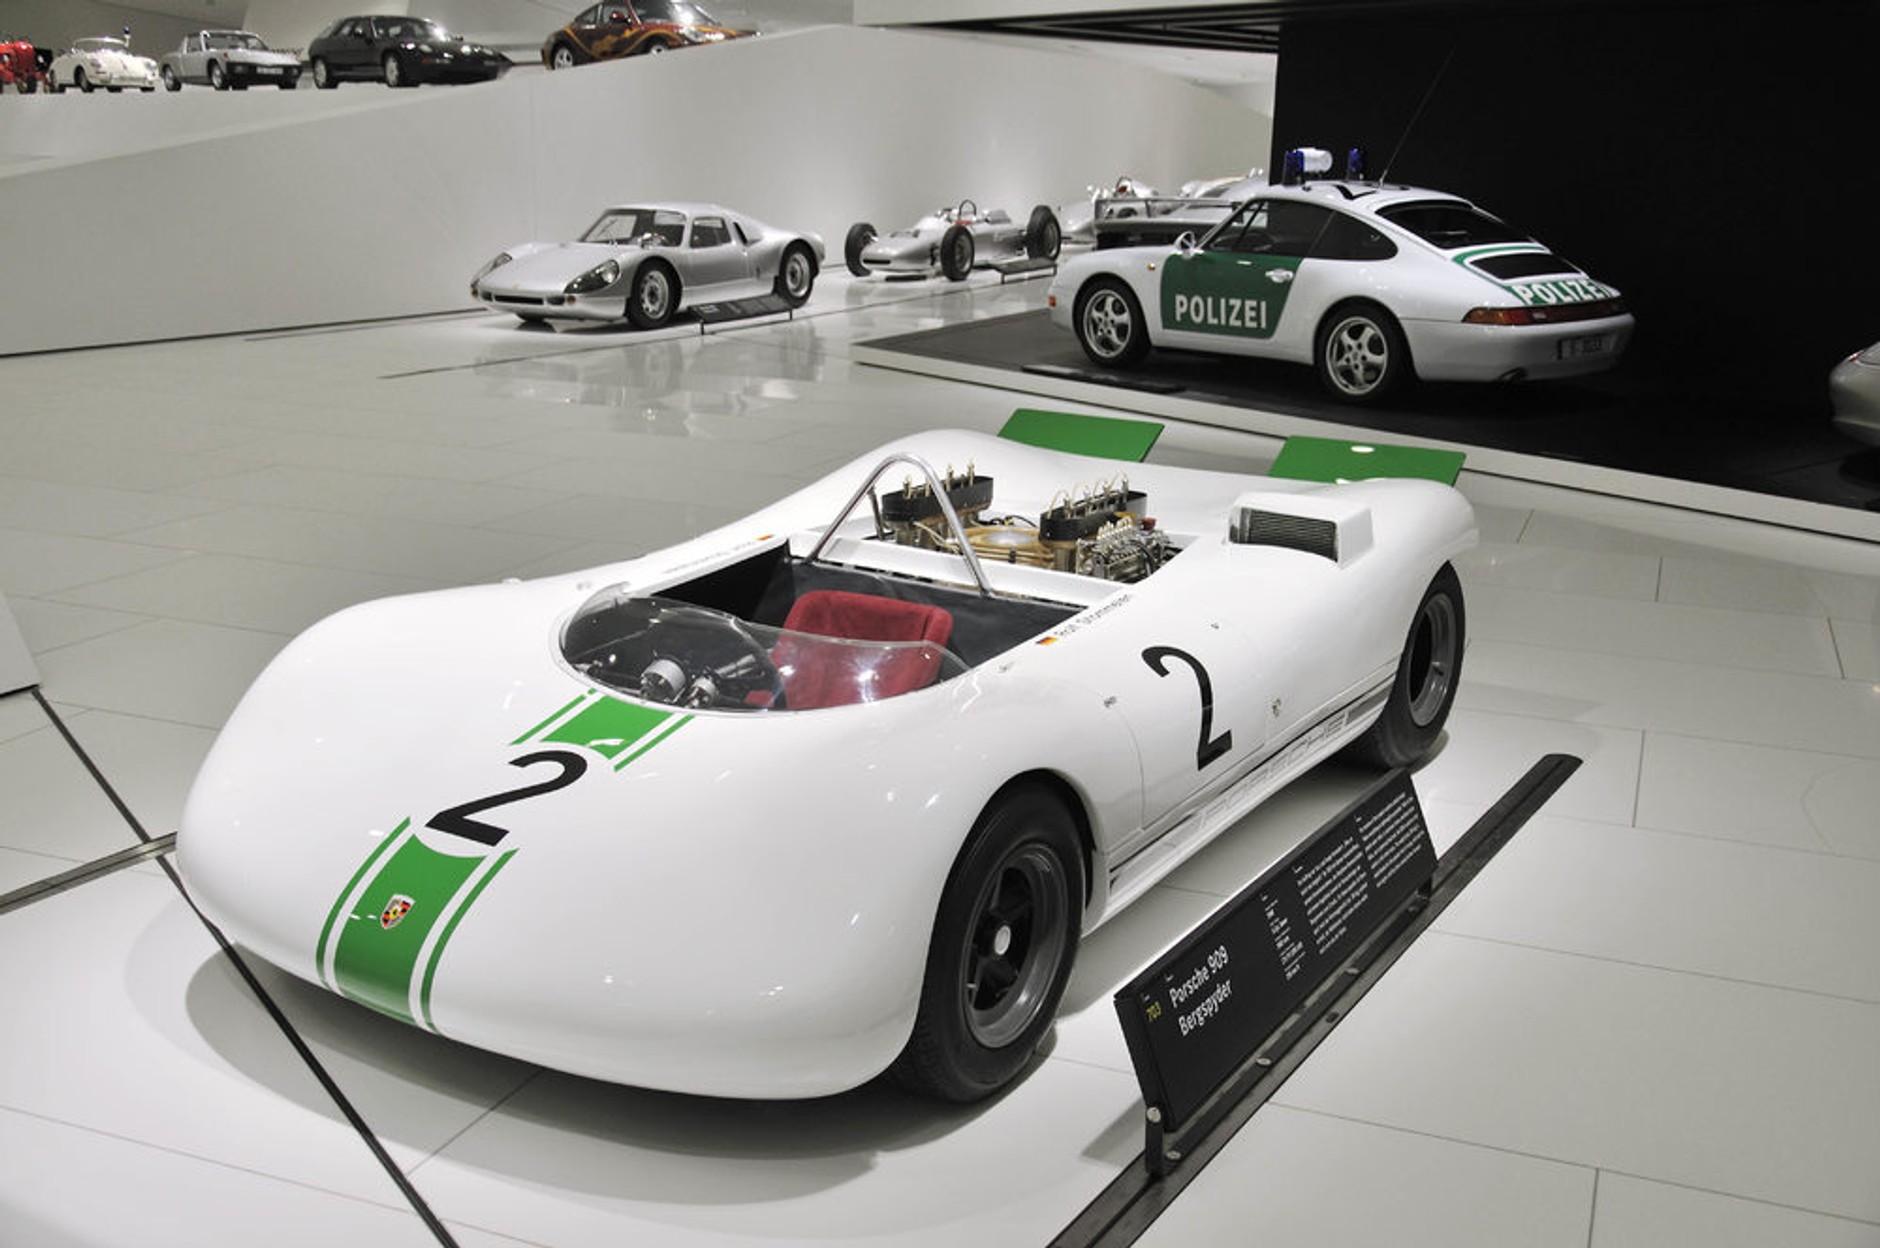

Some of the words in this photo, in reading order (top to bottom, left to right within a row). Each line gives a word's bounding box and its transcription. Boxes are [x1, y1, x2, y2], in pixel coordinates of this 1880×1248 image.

[1174, 293, 1267, 329] POLIZEI
[1142, 646, 1231, 771] 2
[426, 750, 588, 847] 2
[1169, 967, 1209, 1008] Porsche
[1207, 945, 1229, 973] 909
[1179, 980, 1232, 1036] Bergspyder
